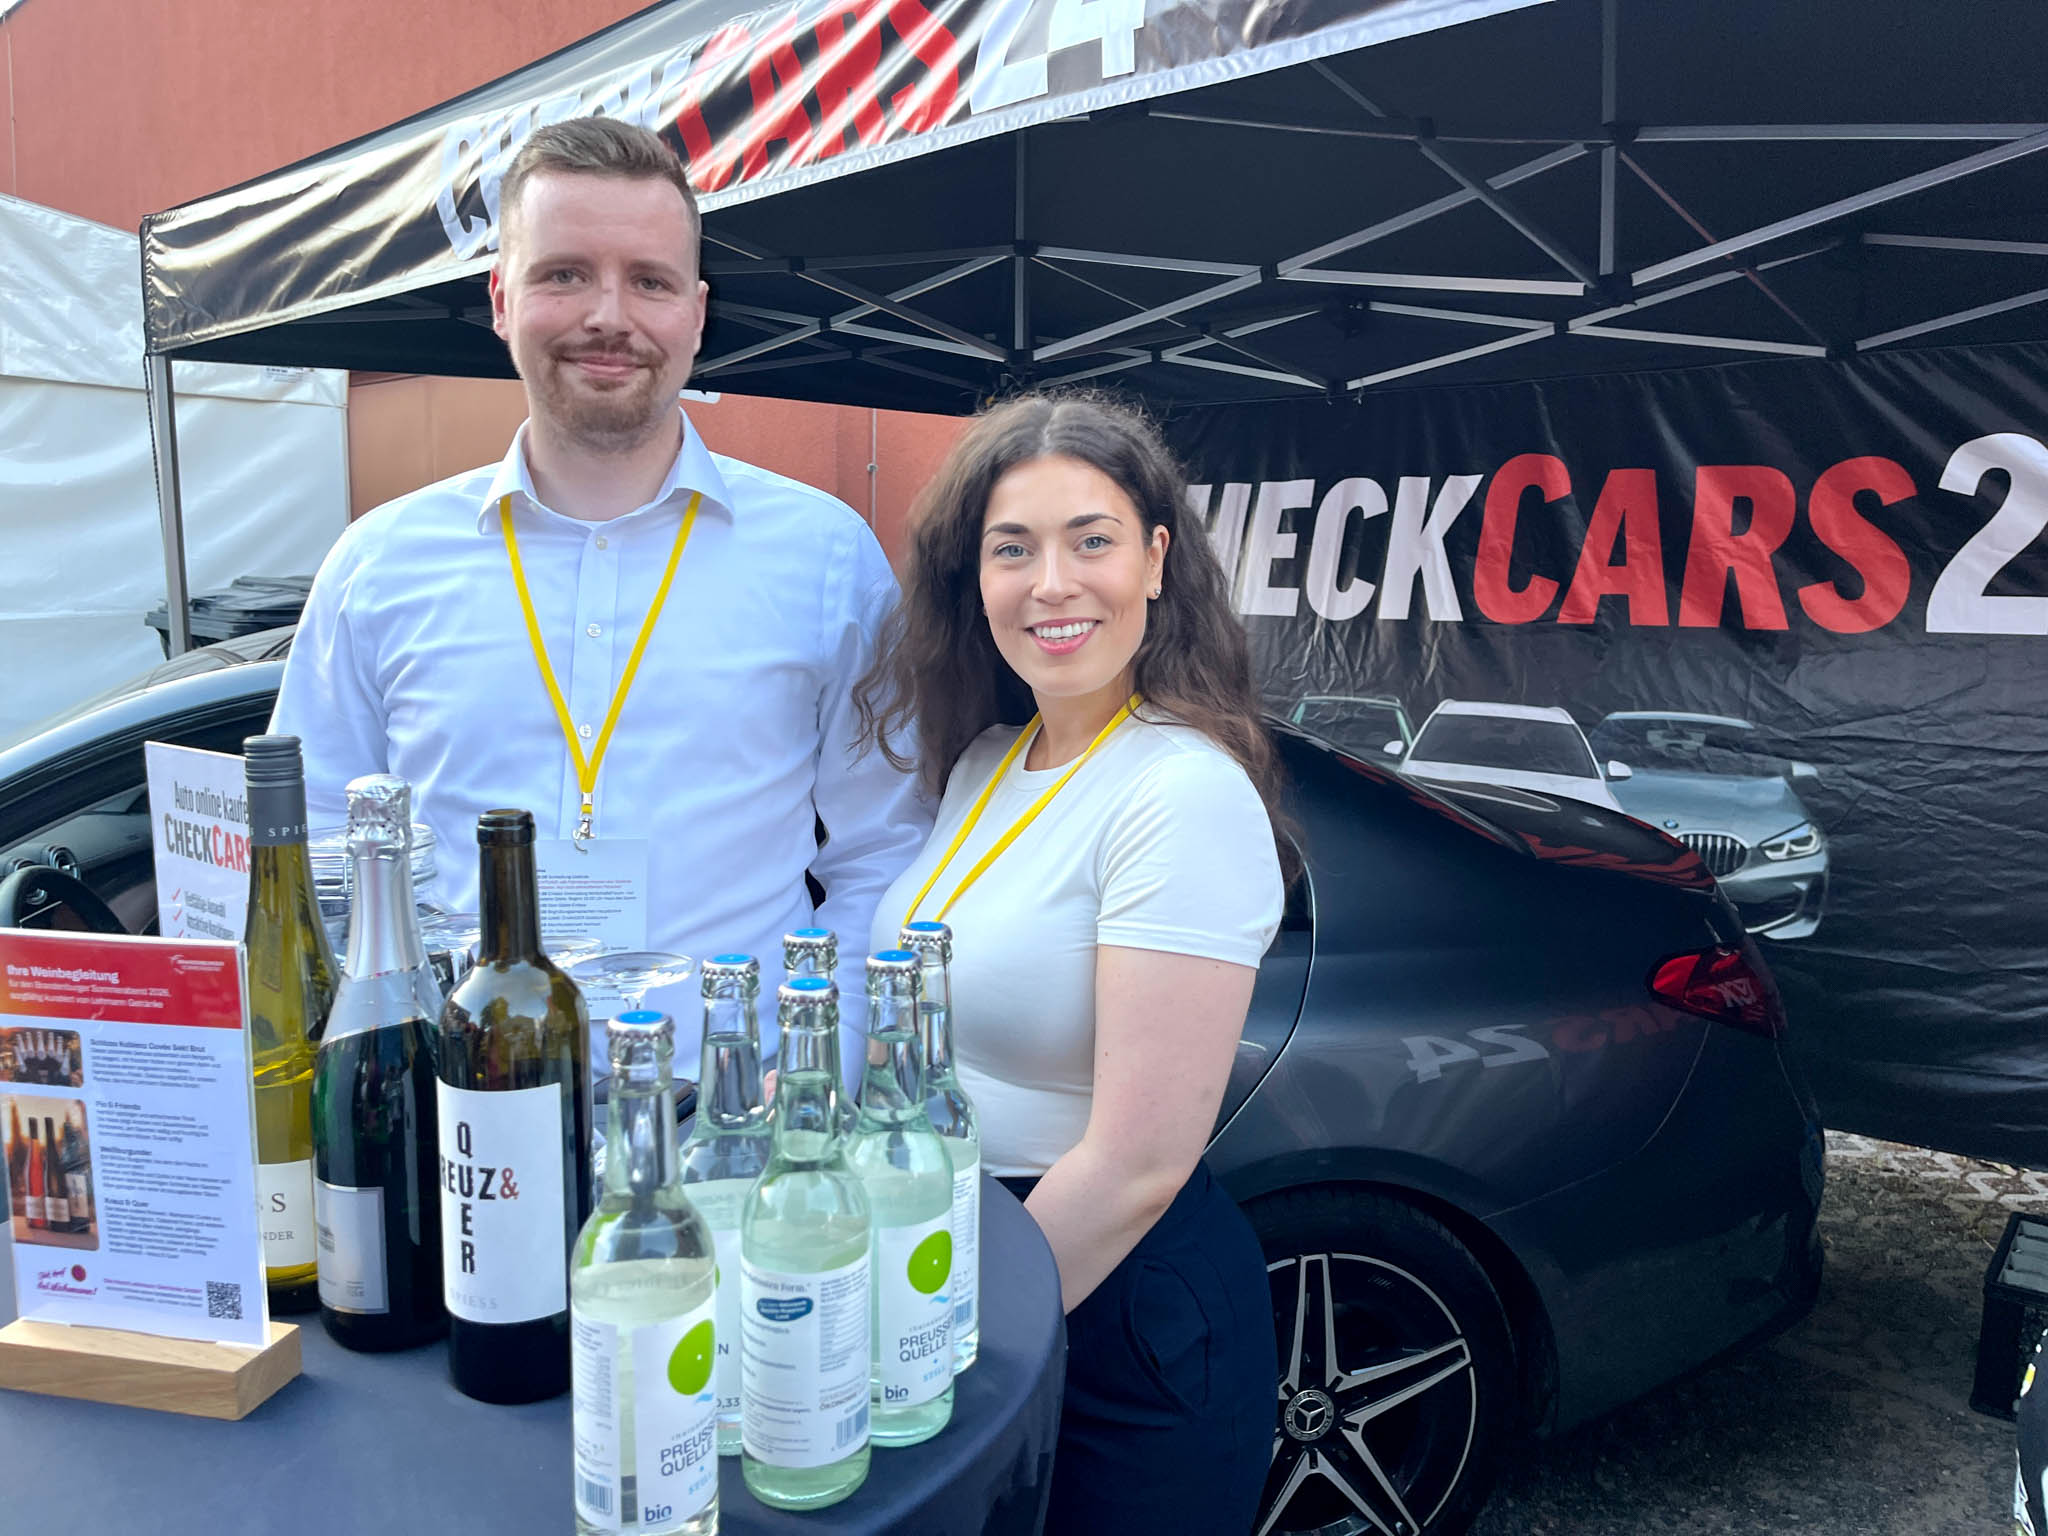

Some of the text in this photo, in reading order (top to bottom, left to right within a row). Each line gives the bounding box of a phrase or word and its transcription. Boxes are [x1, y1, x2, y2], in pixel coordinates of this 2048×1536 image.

[174, 781, 194, 811] Auto
[196, 786, 221, 819] online
[7, 964, 120, 985] Ihre Weinbegleitung
[899, 1333, 947, 1363] QUELLE
[885, 1384, 909, 1401] bio
[661, 1434, 713, 1477] QUELLE
[645, 1504, 672, 1522] bio
